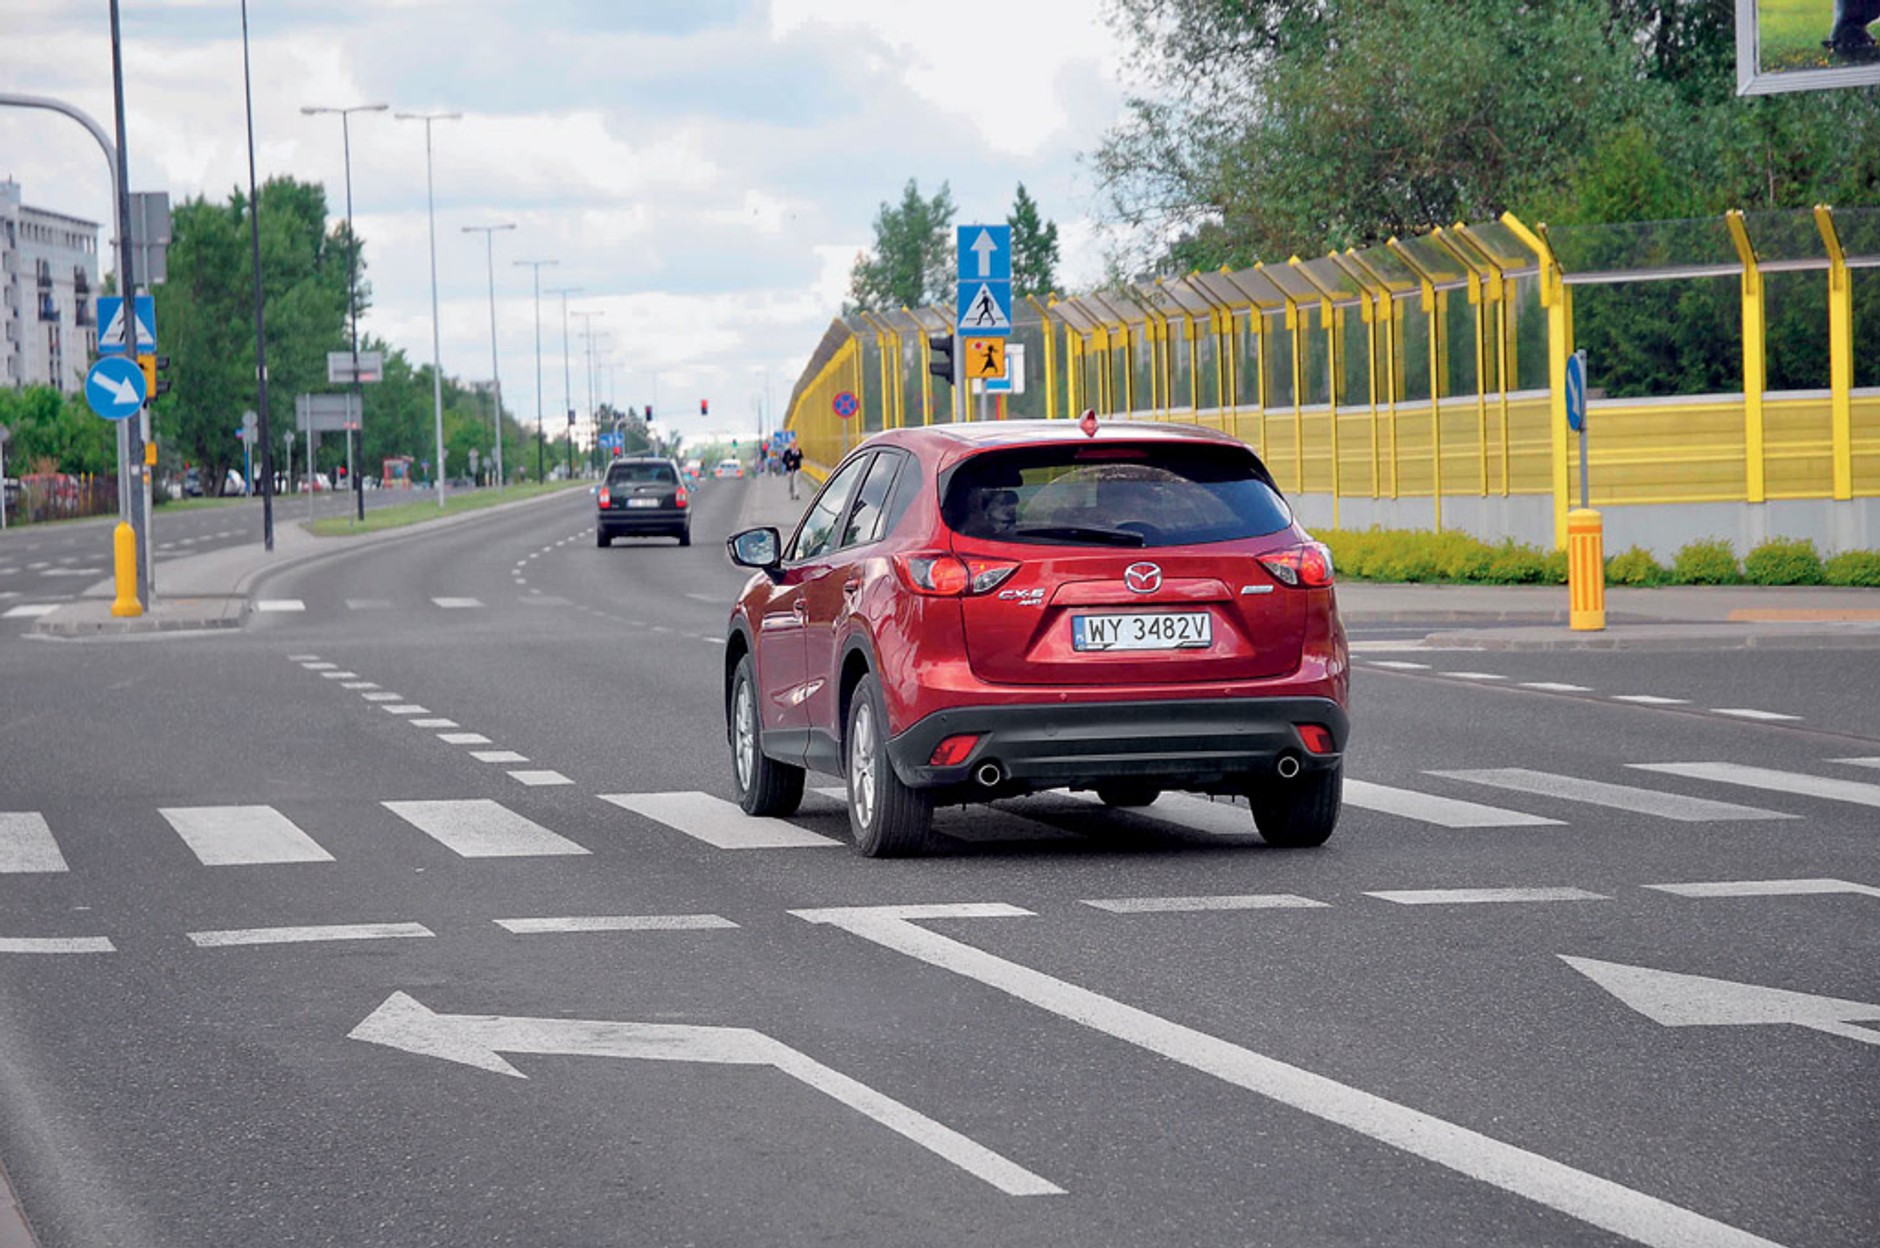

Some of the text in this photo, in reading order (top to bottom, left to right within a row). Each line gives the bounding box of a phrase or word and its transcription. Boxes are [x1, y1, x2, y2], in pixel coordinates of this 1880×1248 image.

[998, 588, 1045, 600] CX-5
[1088, 616, 1205, 642] WY 3482V
